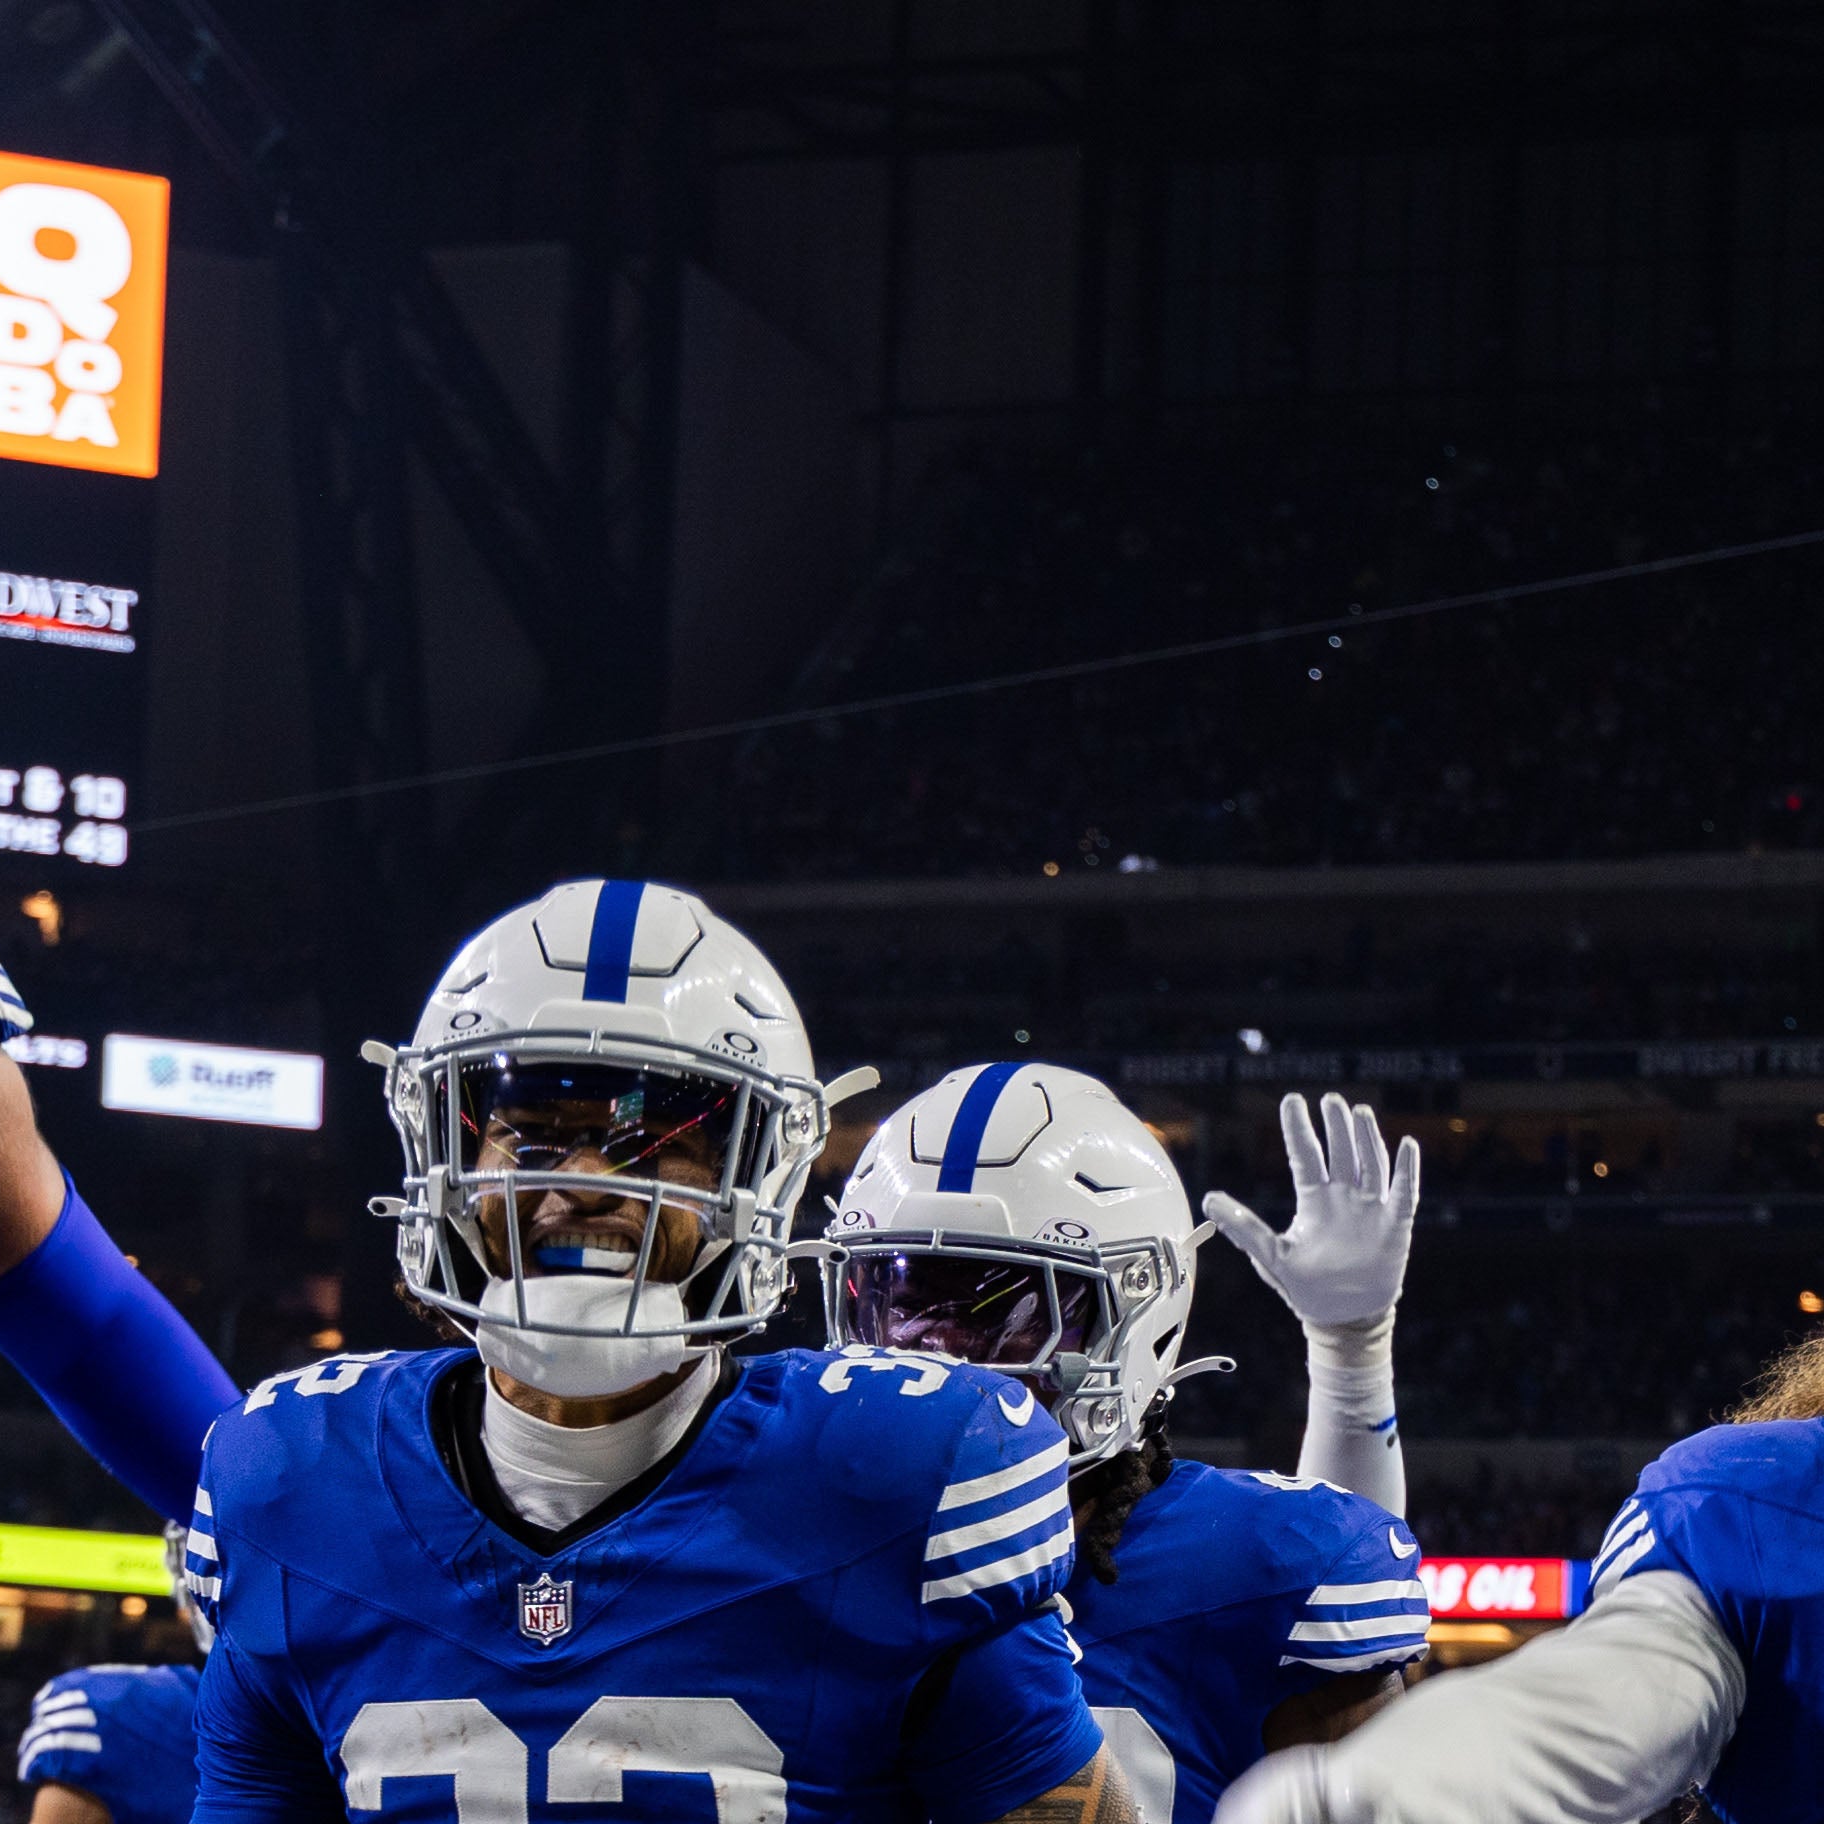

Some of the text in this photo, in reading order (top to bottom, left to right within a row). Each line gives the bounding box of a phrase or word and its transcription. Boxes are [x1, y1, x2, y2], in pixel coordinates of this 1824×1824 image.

[69, 773, 127, 820] 10
[1467, 1563, 1537, 1612] OIL
[528, 1606, 564, 1633] NFL
